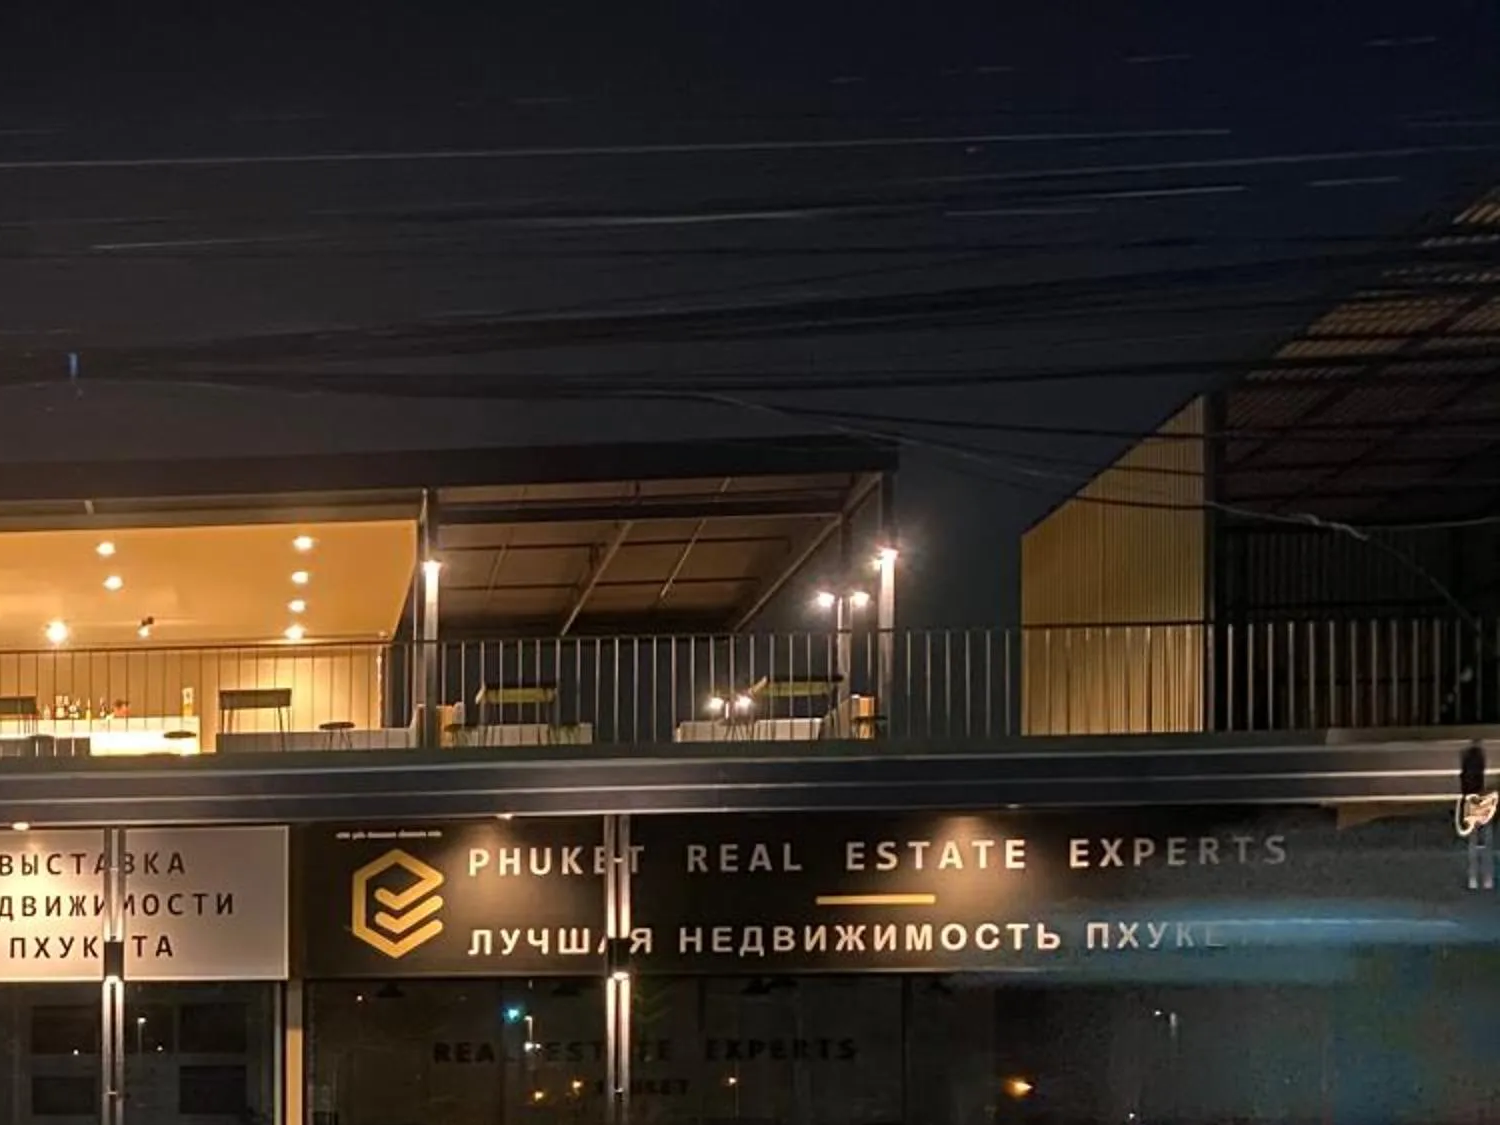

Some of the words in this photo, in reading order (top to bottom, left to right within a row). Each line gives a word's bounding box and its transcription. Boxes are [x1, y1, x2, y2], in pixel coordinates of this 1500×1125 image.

[468, 844, 645, 877] PHUKET
[687, 843, 803, 873] REAL
[846, 838, 1026, 871] ESTATE
[1069, 835, 1287, 868] EXPERTS
[9, 935, 174, 959] ПХУКТА
[679, 922, 1062, 957] НЕДВИЖИМОСТЬ
[546, 1040, 671, 1063] ESTTE
[705, 1036, 857, 1061] EXPERTS
